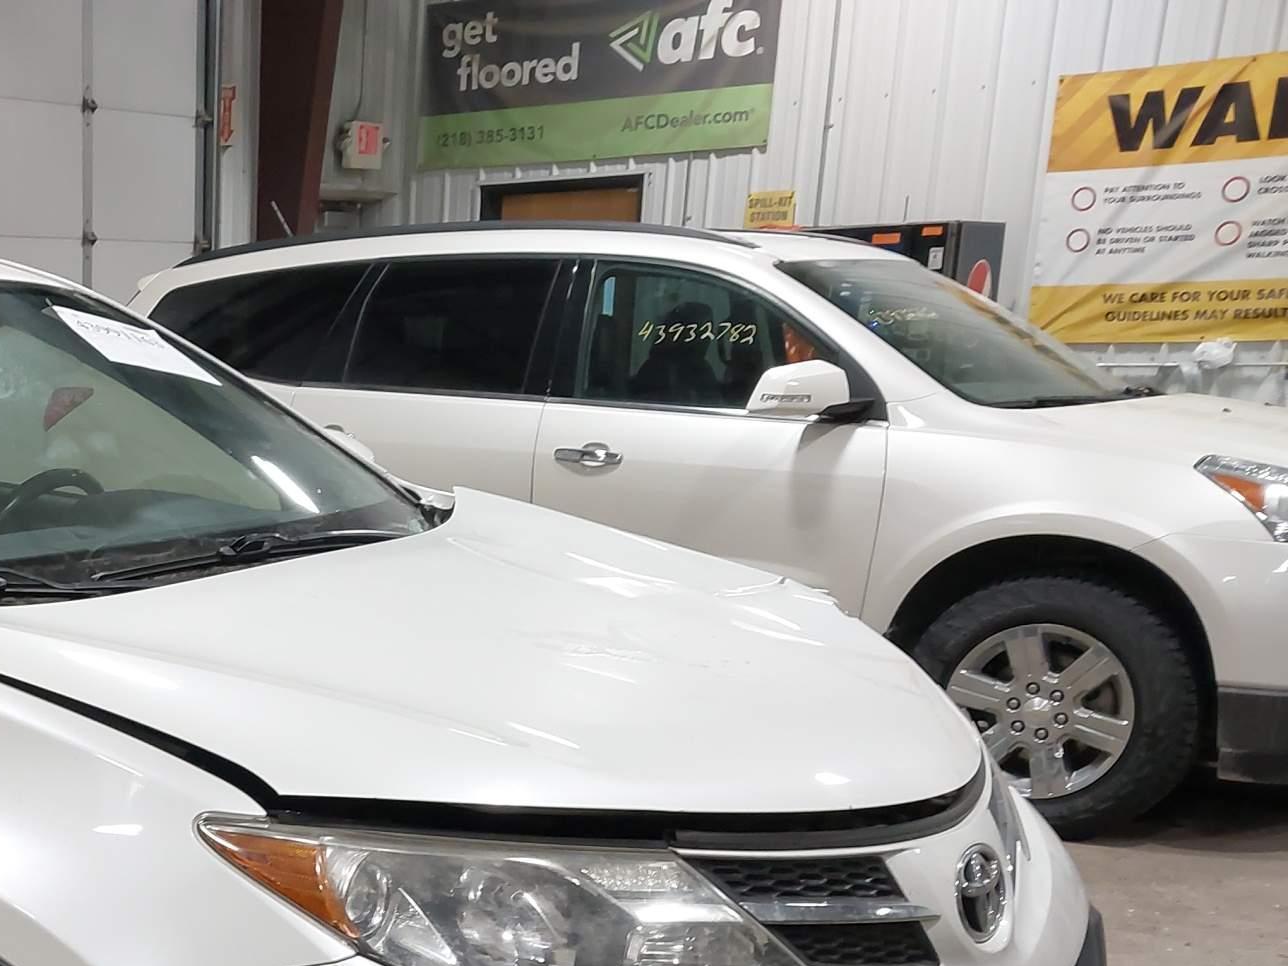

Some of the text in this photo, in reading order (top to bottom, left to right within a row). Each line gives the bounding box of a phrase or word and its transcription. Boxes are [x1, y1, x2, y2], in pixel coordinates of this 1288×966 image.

[442, 11, 498, 58] get
[657, 0, 761, 64] afc
[457, 42, 580, 91] floored
[620, 110, 749, 132] AFCDealer.com
[1108, 77, 1288, 152] WA
[436, 125, 544, 148] (218) 385-3131
[1122, 183, 1171, 193] ATTENTION
[1156, 223, 1192, 233] SHOULD
[1103, 287, 1288, 304] WE CARE FOR YOUR SAF
[1104, 306, 1288, 322] GUIDELINES MAY RESULT
[638, 320, 757, 345] 43932782
